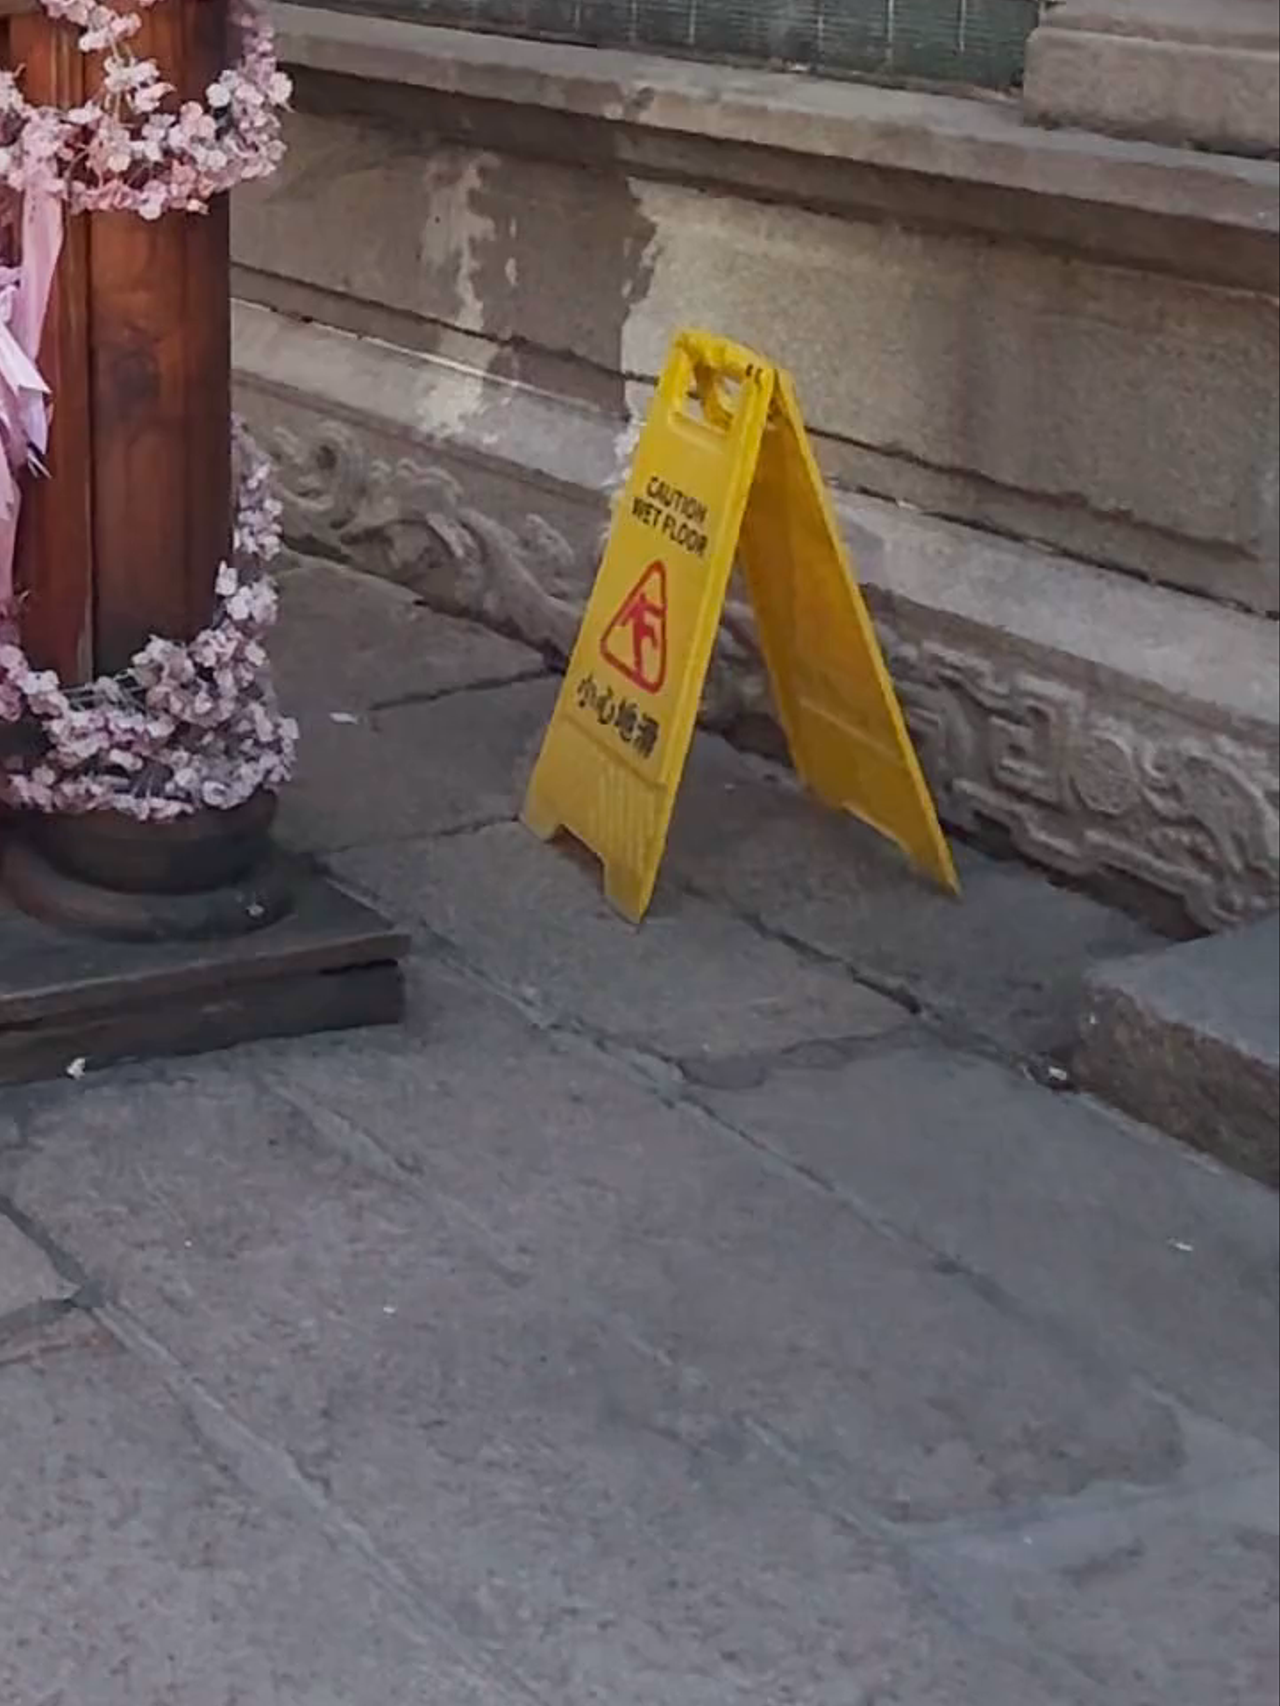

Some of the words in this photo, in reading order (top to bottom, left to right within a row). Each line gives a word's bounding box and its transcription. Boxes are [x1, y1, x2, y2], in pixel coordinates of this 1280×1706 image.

[632, 496, 662, 528] WET
[662, 513, 708, 558] FLOOR
[646, 475, 708, 524] CAUTION
